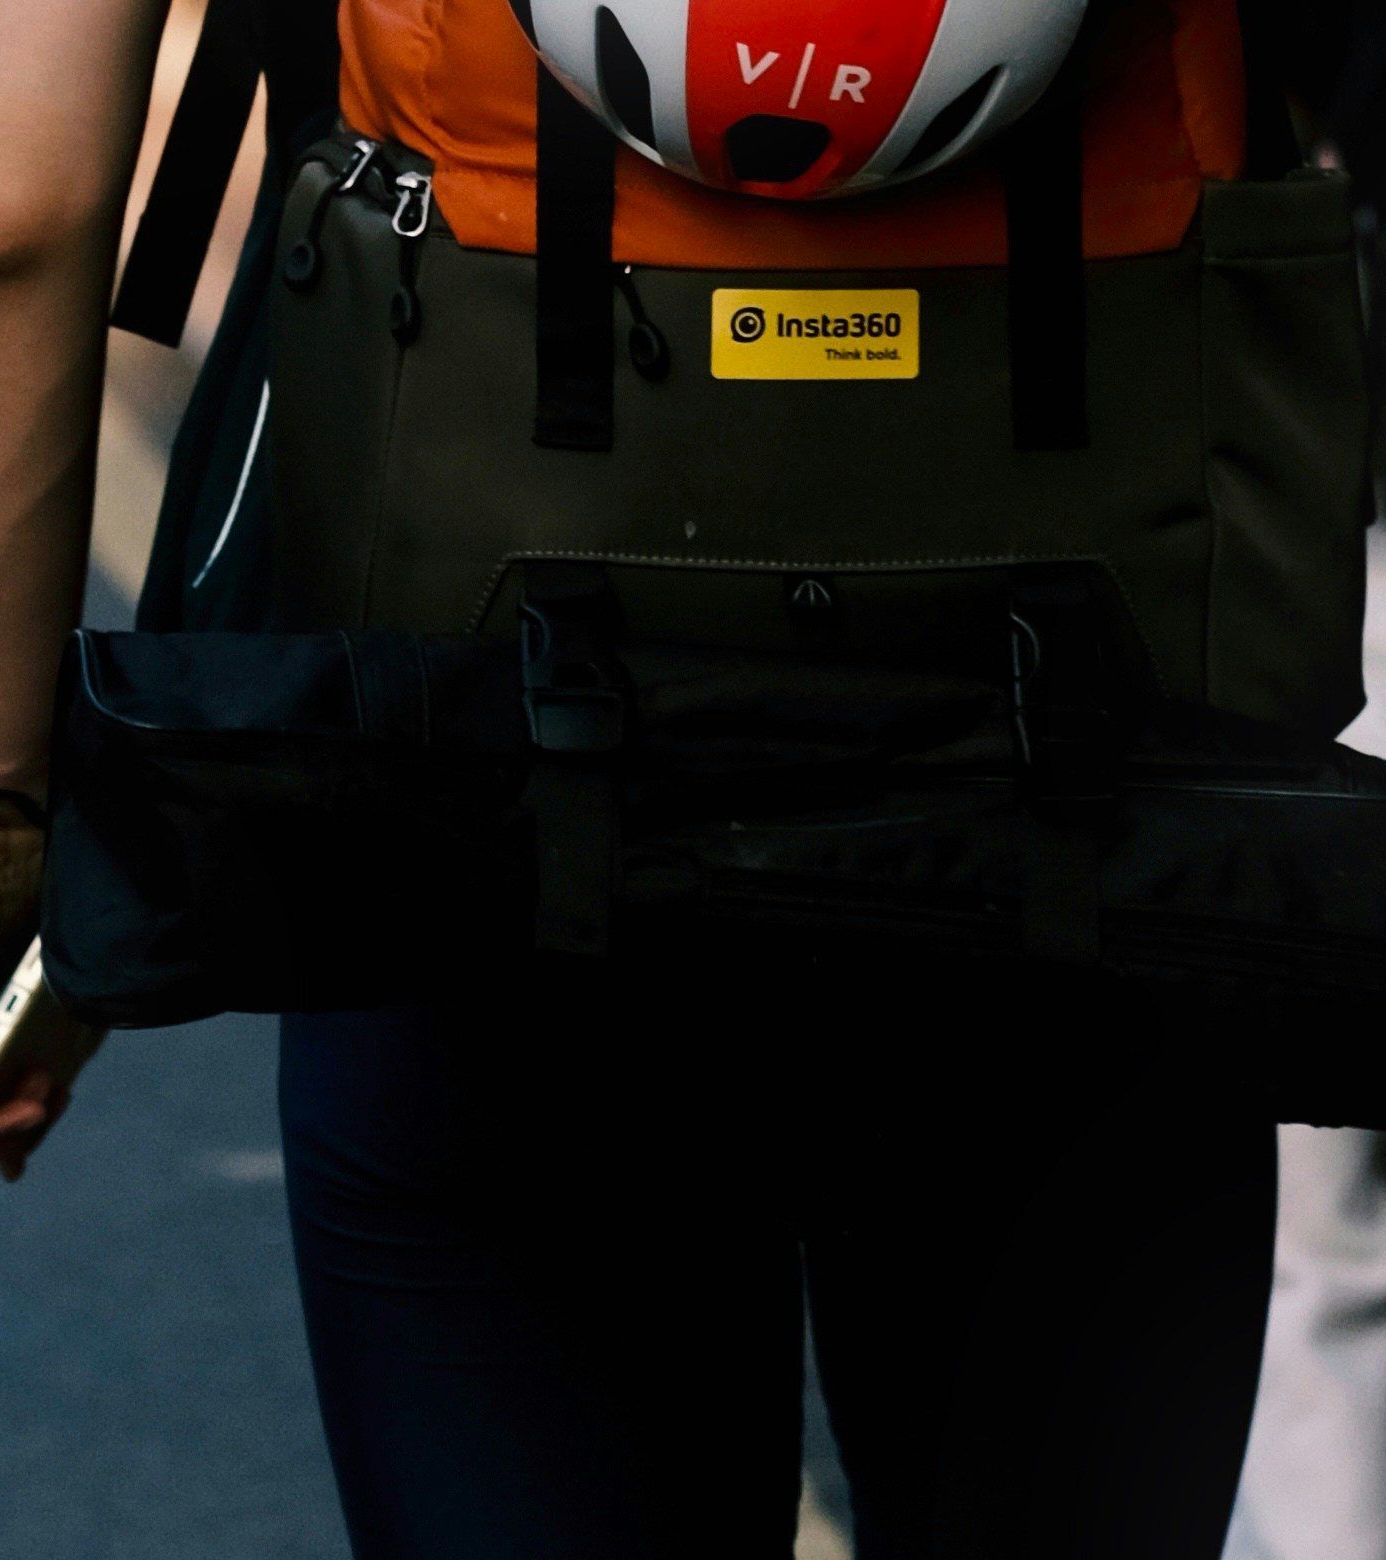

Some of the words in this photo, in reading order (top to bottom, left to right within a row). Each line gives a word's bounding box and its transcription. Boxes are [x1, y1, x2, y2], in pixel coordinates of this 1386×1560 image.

[777, 312, 901, 338] Insta360
[825, 348, 861, 360] Think
[866, 348, 901, 360] bold.
